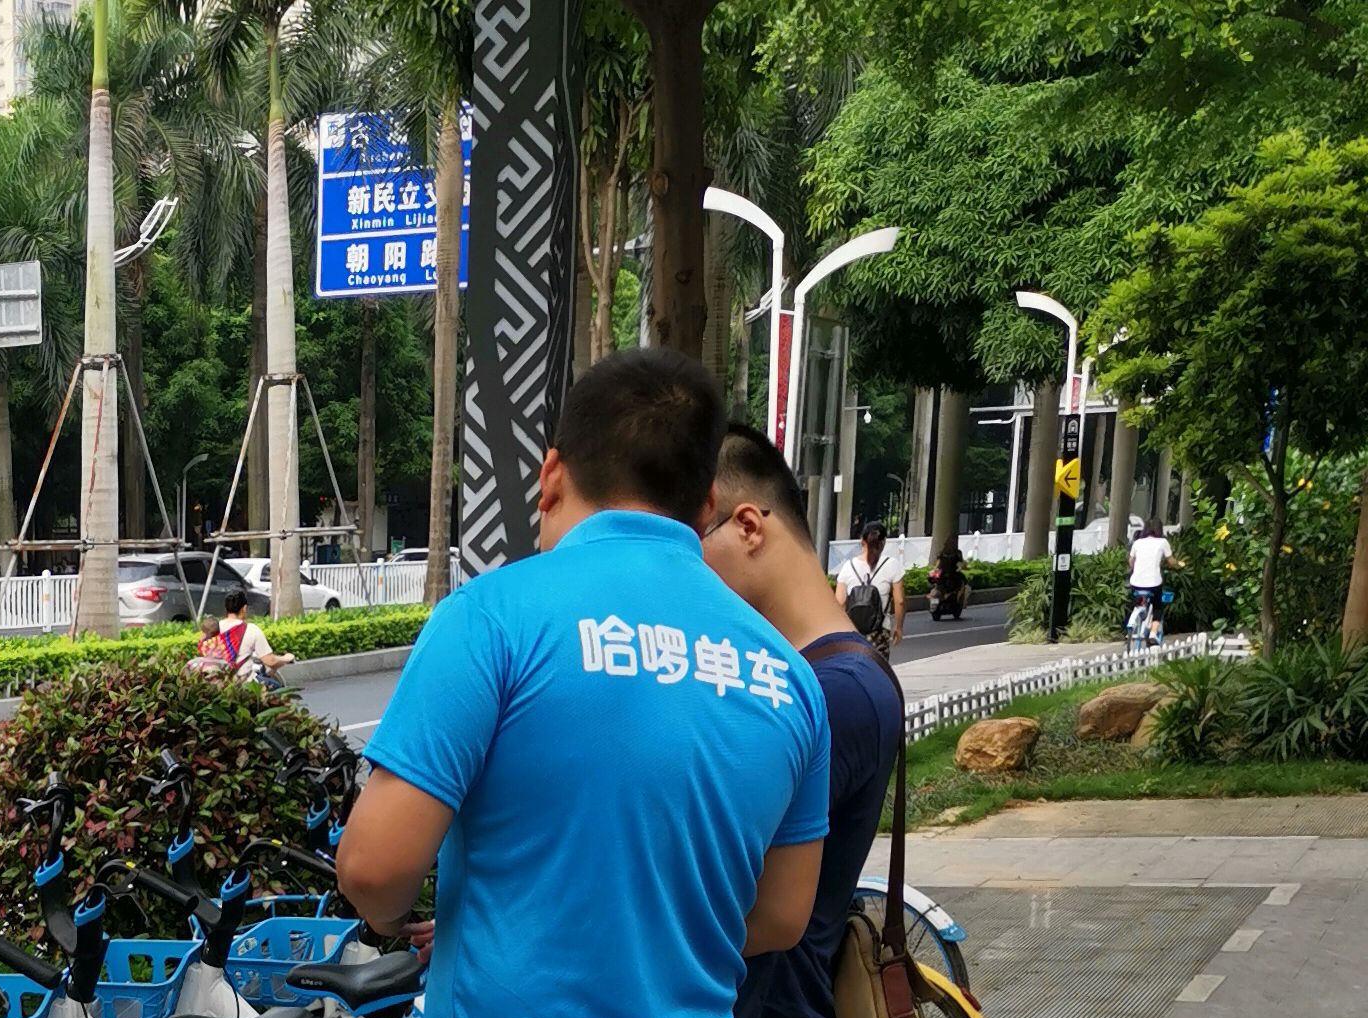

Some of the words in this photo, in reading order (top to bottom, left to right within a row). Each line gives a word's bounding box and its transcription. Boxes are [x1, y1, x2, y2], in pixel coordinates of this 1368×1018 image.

[351, 215, 395, 231] Xinmin
[345, 238, 438, 273] 朝阳路
[347, 272, 407, 288] Chaoyang
[578, 614, 794, 709] 哈啰单车
